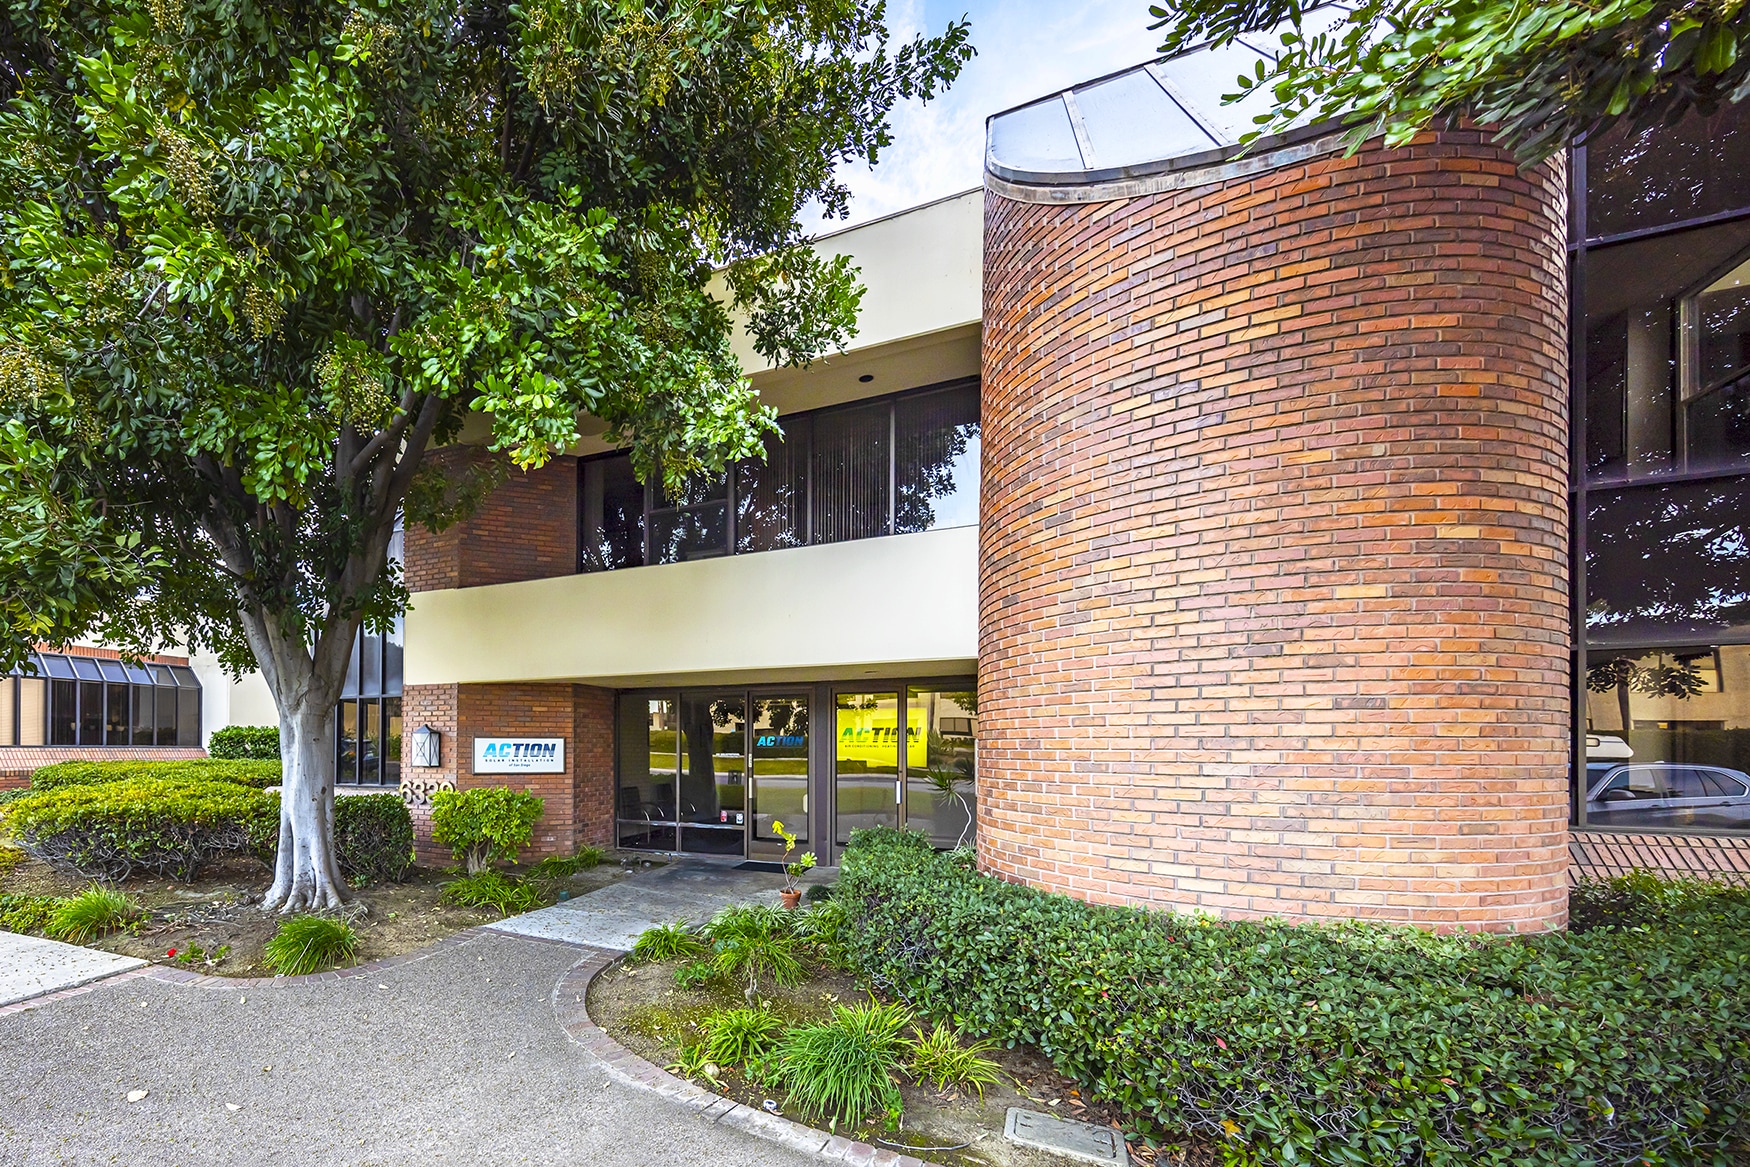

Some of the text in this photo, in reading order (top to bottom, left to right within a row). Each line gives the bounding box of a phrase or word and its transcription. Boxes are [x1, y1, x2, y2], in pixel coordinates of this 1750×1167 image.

[756, 735, 804, 747] ACTION
[839, 727, 922, 743] ACTION
[482, 743, 556, 758] ACTION
